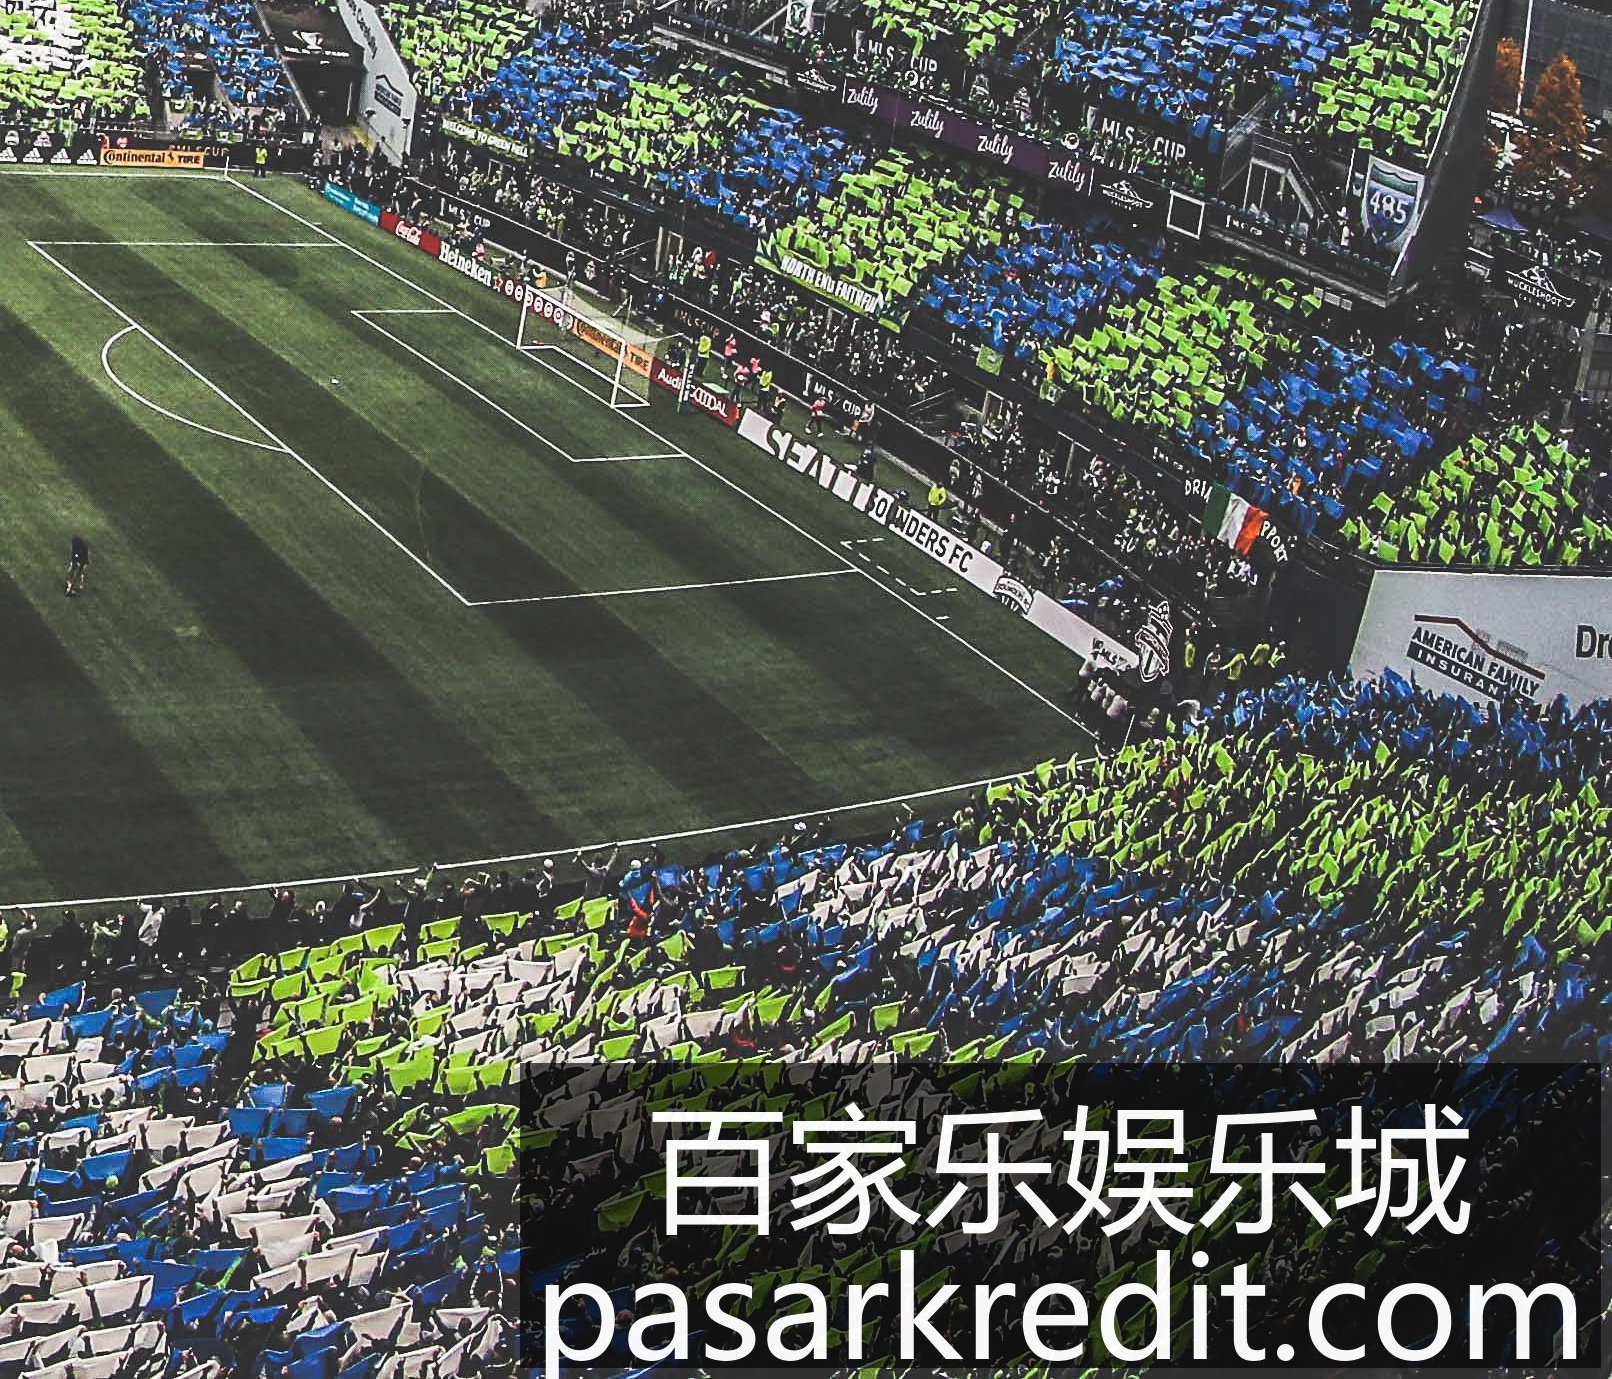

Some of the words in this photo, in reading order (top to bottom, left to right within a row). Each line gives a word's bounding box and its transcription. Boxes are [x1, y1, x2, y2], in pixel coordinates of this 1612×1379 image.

[441, 119, 476, 140] WELCOME
[477, 131, 487, 143] TO
[487, 134, 511, 153] GREEN
[511, 143, 529, 158] HELL
[103, 149, 166, 164] Continental
[177, 154, 201, 165] TIRE
[1369, 189, 1408, 225] 485
[439, 240, 493, 287] Heineken
[780, 254, 815, 285] NORTH
[1507, 277, 1563, 307] MUCKLESHOOT
[629, 353, 650, 372] TIRE
[657, 368, 683, 392] Audi
[948, 546, 974, 573] FC
[1411, 626, 1486, 673] AMERICAN
[1487, 661, 1540, 698] FAMILY
